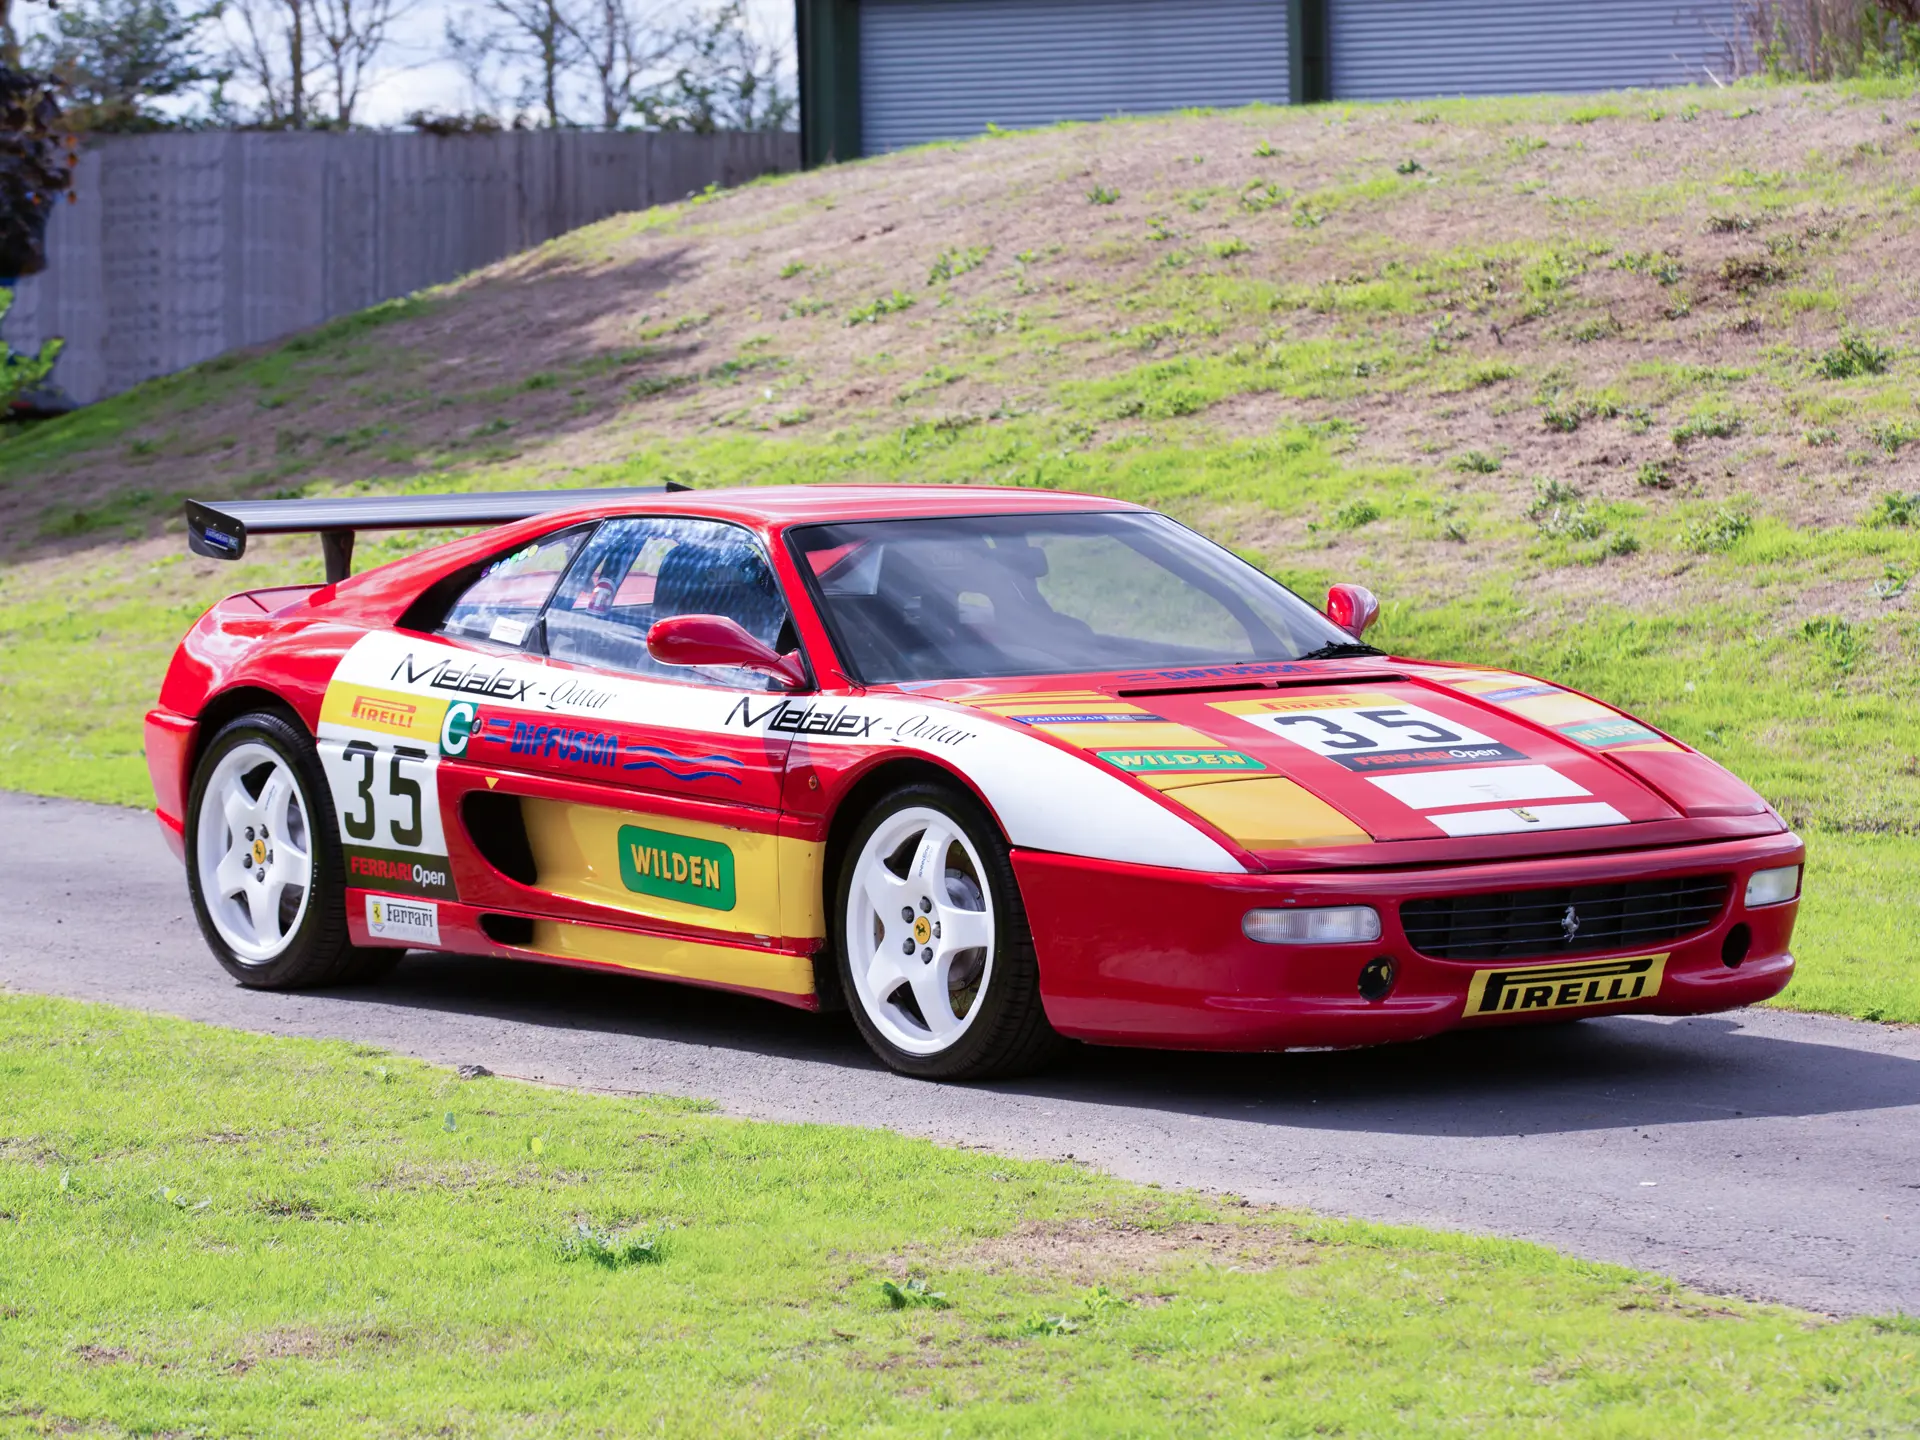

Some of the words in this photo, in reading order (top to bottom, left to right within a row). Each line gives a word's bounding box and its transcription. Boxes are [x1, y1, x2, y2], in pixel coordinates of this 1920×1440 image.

[391, 653, 537, 702] Metalex
[351, 696, 416, 729] PIRELLI
[724, 697, 882, 738] Metalex
[1259, 698, 1360, 711] PIRELLI
[1273, 710, 1463, 749] 35
[1112, 754, 1249, 767] WILDEN
[1352, 751, 1450, 766] FERRARI
[1449, 748, 1502, 760] Open
[342, 740, 428, 847] 35
[350, 855, 412, 883] FERRARI
[412, 864, 446, 888] Open
[630, 843, 720, 892] WILDEN
[386, 903, 434, 928] Ferrari
[1477, 957, 1655, 1013] PIRELLI
